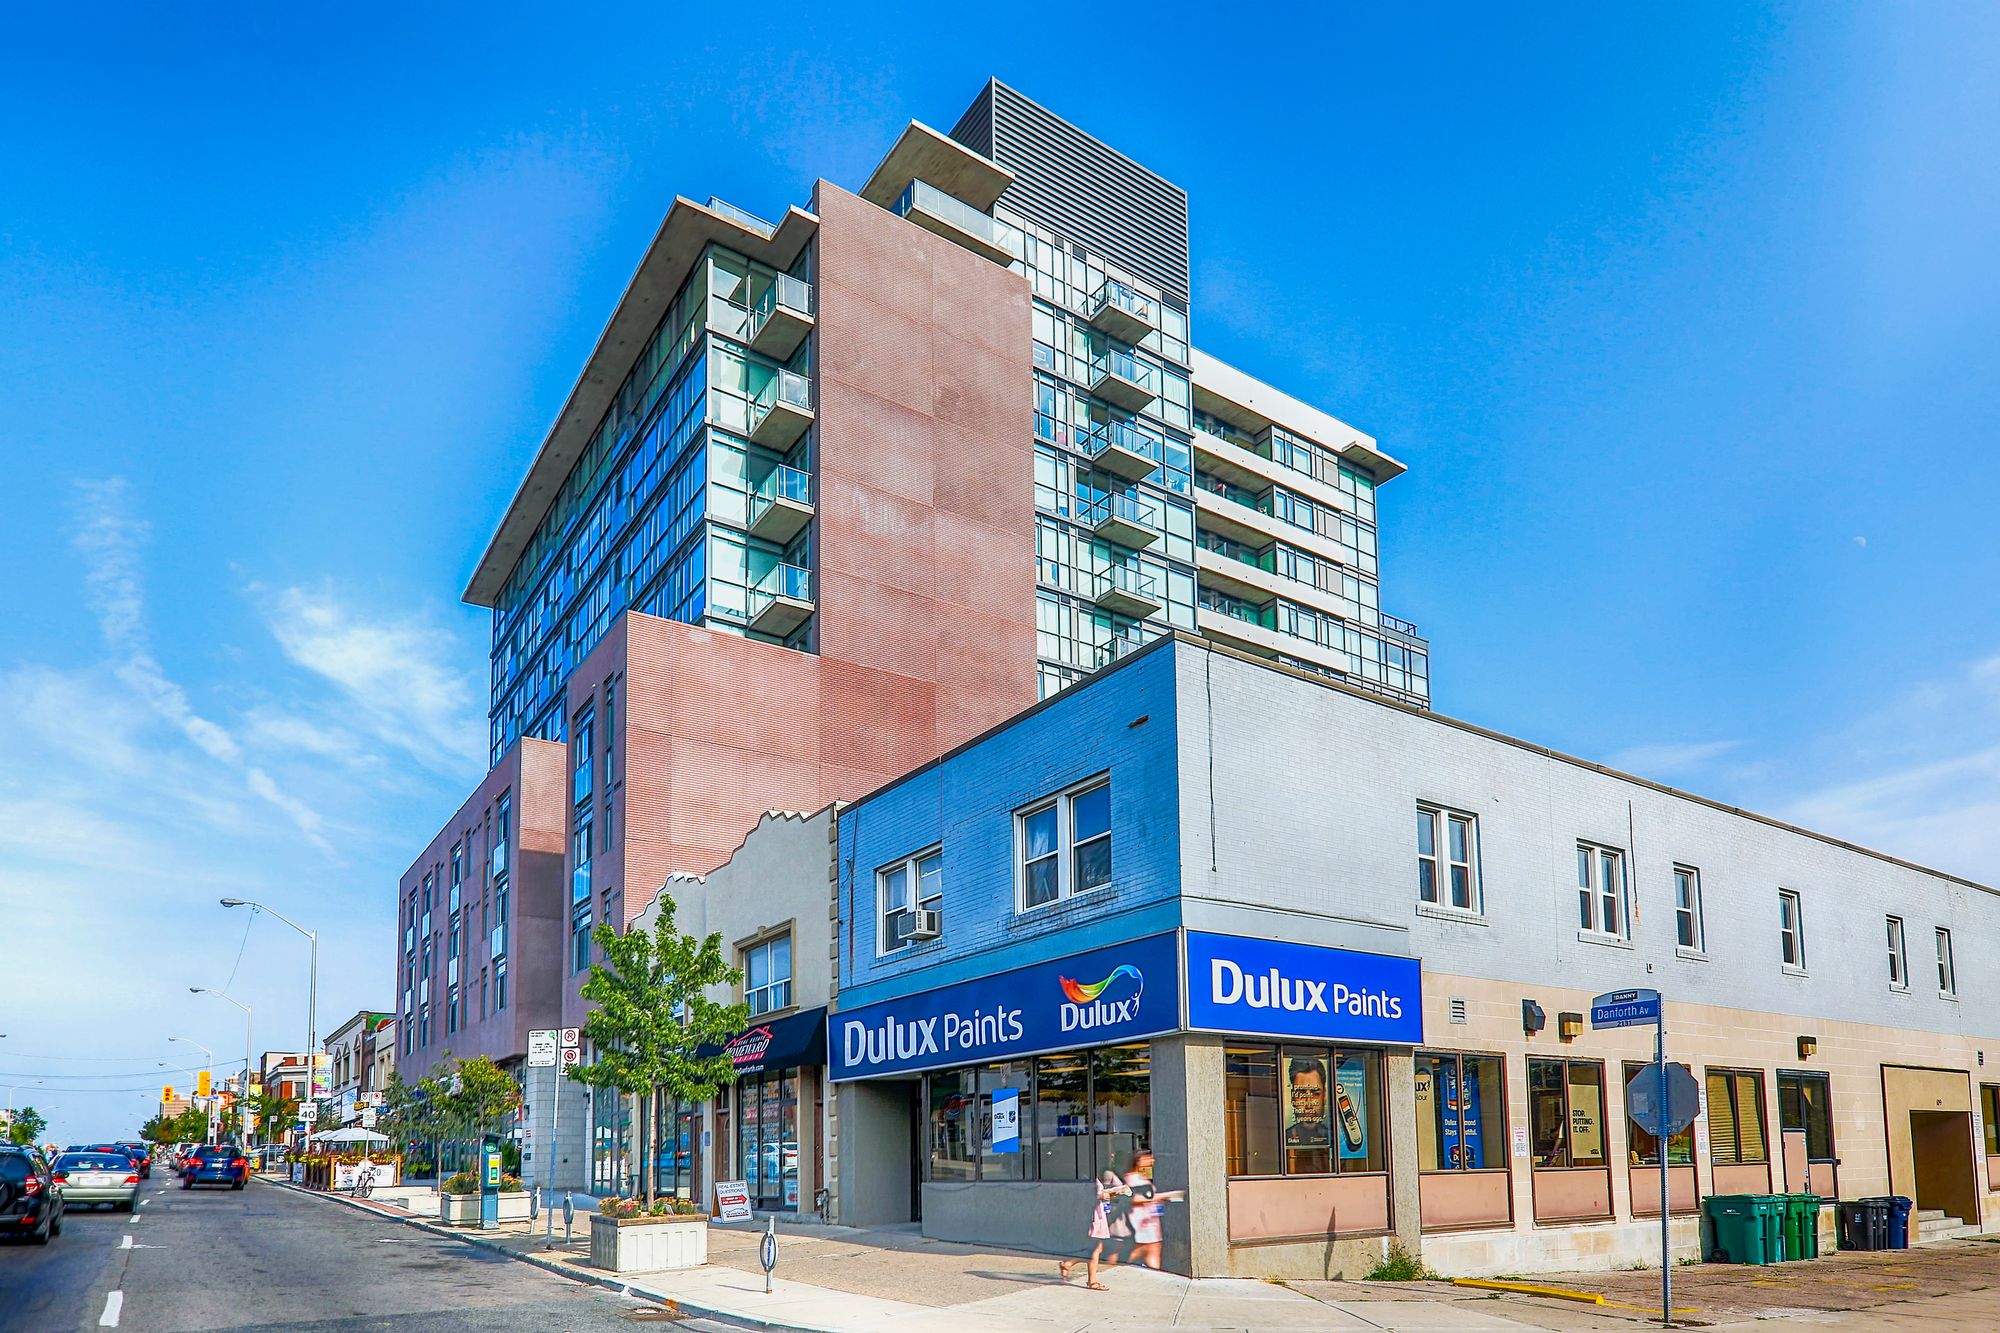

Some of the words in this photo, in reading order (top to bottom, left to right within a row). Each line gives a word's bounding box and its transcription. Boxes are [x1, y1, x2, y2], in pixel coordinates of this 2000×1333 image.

[1211, 958, 1328, 1013] Dulux
[1333, 983, 1402, 1019] Paints
[1060, 999, 1132, 1032] Dulux
[1597, 1005, 1637, 1020] Danforth
[1639, 1006, 1650, 1016] Av
[844, 1016, 938, 1067] Dulux
[944, 1005, 1023, 1051] Paints
[301, 1111, 315, 1119] 40
[1572, 1117, 1595, 1126] PUTTING.
